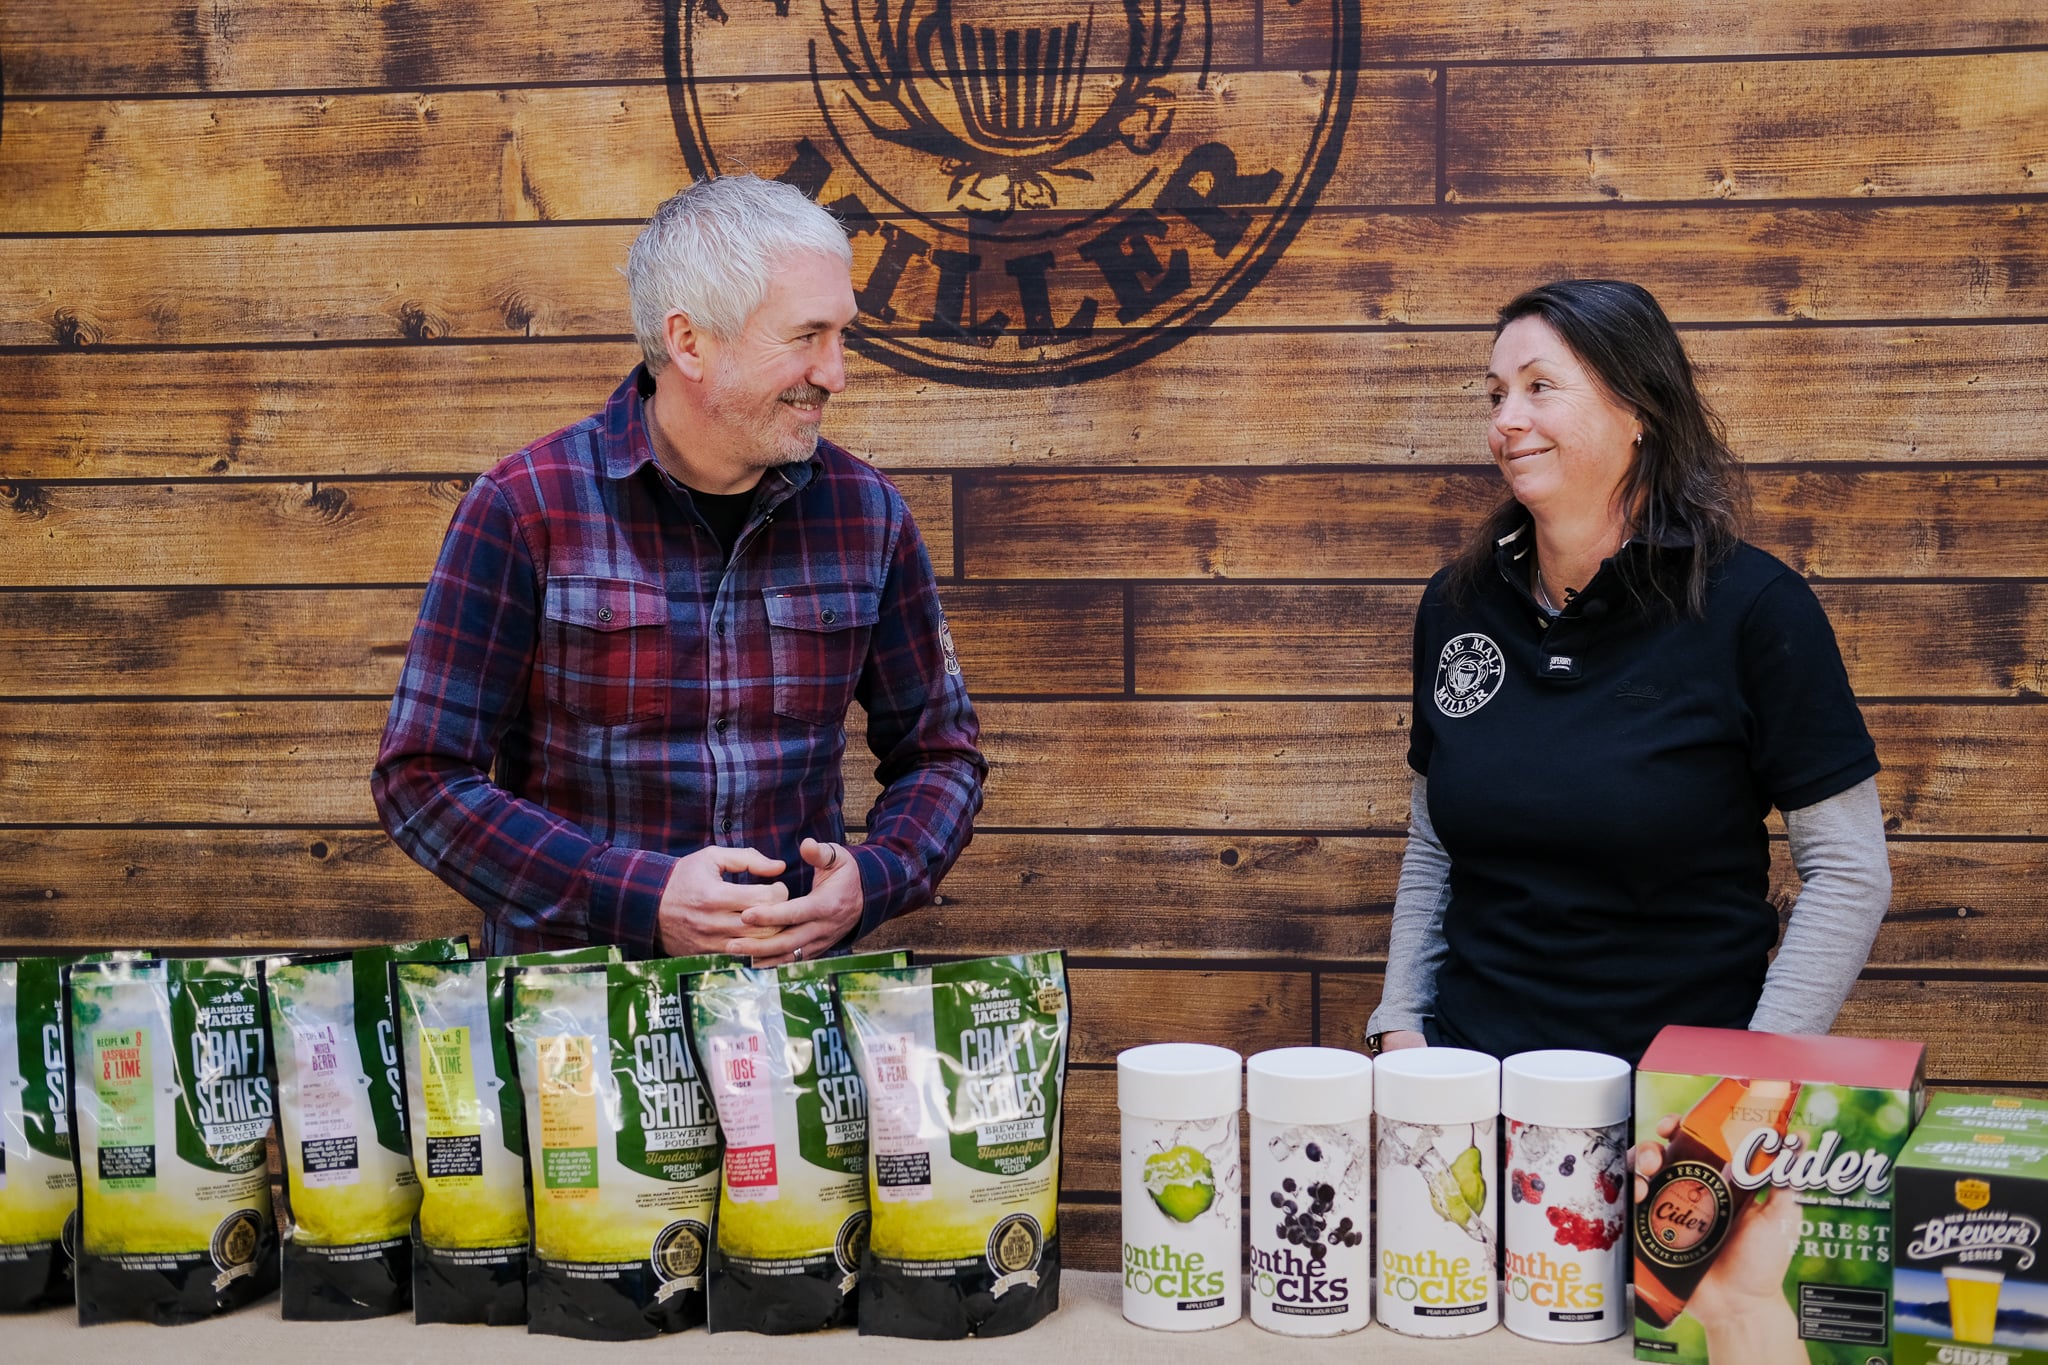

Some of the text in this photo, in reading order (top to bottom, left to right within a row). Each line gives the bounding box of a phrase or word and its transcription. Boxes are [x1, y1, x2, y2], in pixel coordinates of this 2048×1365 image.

[1440, 638, 1500, 676] THE MALT
[1437, 686, 1488, 712] MILLER
[200, 1004, 255, 1015] MANGROVE
[645, 1008, 681, 1018] MNGR
[970, 999, 1022, 1012] MANGROVE
[204, 1013, 254, 1028] JACK'S
[648, 1016, 682, 1032] JAC
[974, 1007, 1020, 1026] JACK'S
[97, 1037, 118, 1047] RECIPE
[136, 1031, 142, 1047] 8
[748, 1035, 758, 1052] 10
[102, 1047, 140, 1061] RASPBERRY
[191, 1028, 265, 1079] CRAFT
[634, 1032, 695, 1083] CRA
[960, 1023, 1037, 1075] CRAFT
[115, 1060, 142, 1079] LIME
[312, 1054, 338, 1071] BERRY
[440, 1055, 463, 1074] LIME
[195, 1077, 273, 1124] SERIES
[817, 1075, 868, 1124] SERI
[966, 1070, 1046, 1120] SERIES
[1729, 1106, 1818, 1127] FESTIVAL
[212, 1121, 264, 1135] BREWERY
[221, 1131, 257, 1141] POUCH
[654, 1128, 708, 1140] BREWERY
[834, 1122, 865, 1134] BREW
[844, 1132, 865, 1141] POU
[985, 1121, 1035, 1135] BREWERY
[995, 1131, 1028, 1142] POUCH
[664, 1138, 699, 1148] POUCH
[978, 1139, 1046, 1160] Handcrafted
[230, 1162, 255, 1172] CIDER
[663, 1163, 702, 1173] PREMIUM
[843, 1156, 863, 1166] PREM
[994, 1155, 1032, 1168] PREMIUM
[1001, 1165, 1026, 1174] CIDER
[1731, 1127, 1892, 1195] Cider
[670, 1171, 696, 1180] CIDER
[1677, 1166, 1728, 1206] FESTIVAL
[1820, 1196, 1841, 1206] with
[1843, 1198, 1865, 1208] Real
[1866, 1200, 1890, 1209] Fruit
[1656, 1201, 1707, 1233] Cider
[1944, 1211, 2008, 1223] NEW ZEALAND
[1780, 1220, 1890, 1242] FOREST
[1923, 1218, 2031, 1252] Brewer's
[1645, 1238, 1670, 1260] FRUIT
[1788, 1240, 1890, 1262] FRUITS
[1959, 1249, 2003, 1262] SERIES
[1125, 1264, 1224, 1298] rocks
[1251, 1266, 1349, 1303] rocks
[1383, 1271, 1488, 1304] rocks
[1505, 1269, 1605, 1308] rocks
[1306, 1307, 1329, 1315] FLAVOUR
[1937, 1346, 2009, 1365] CIDER
